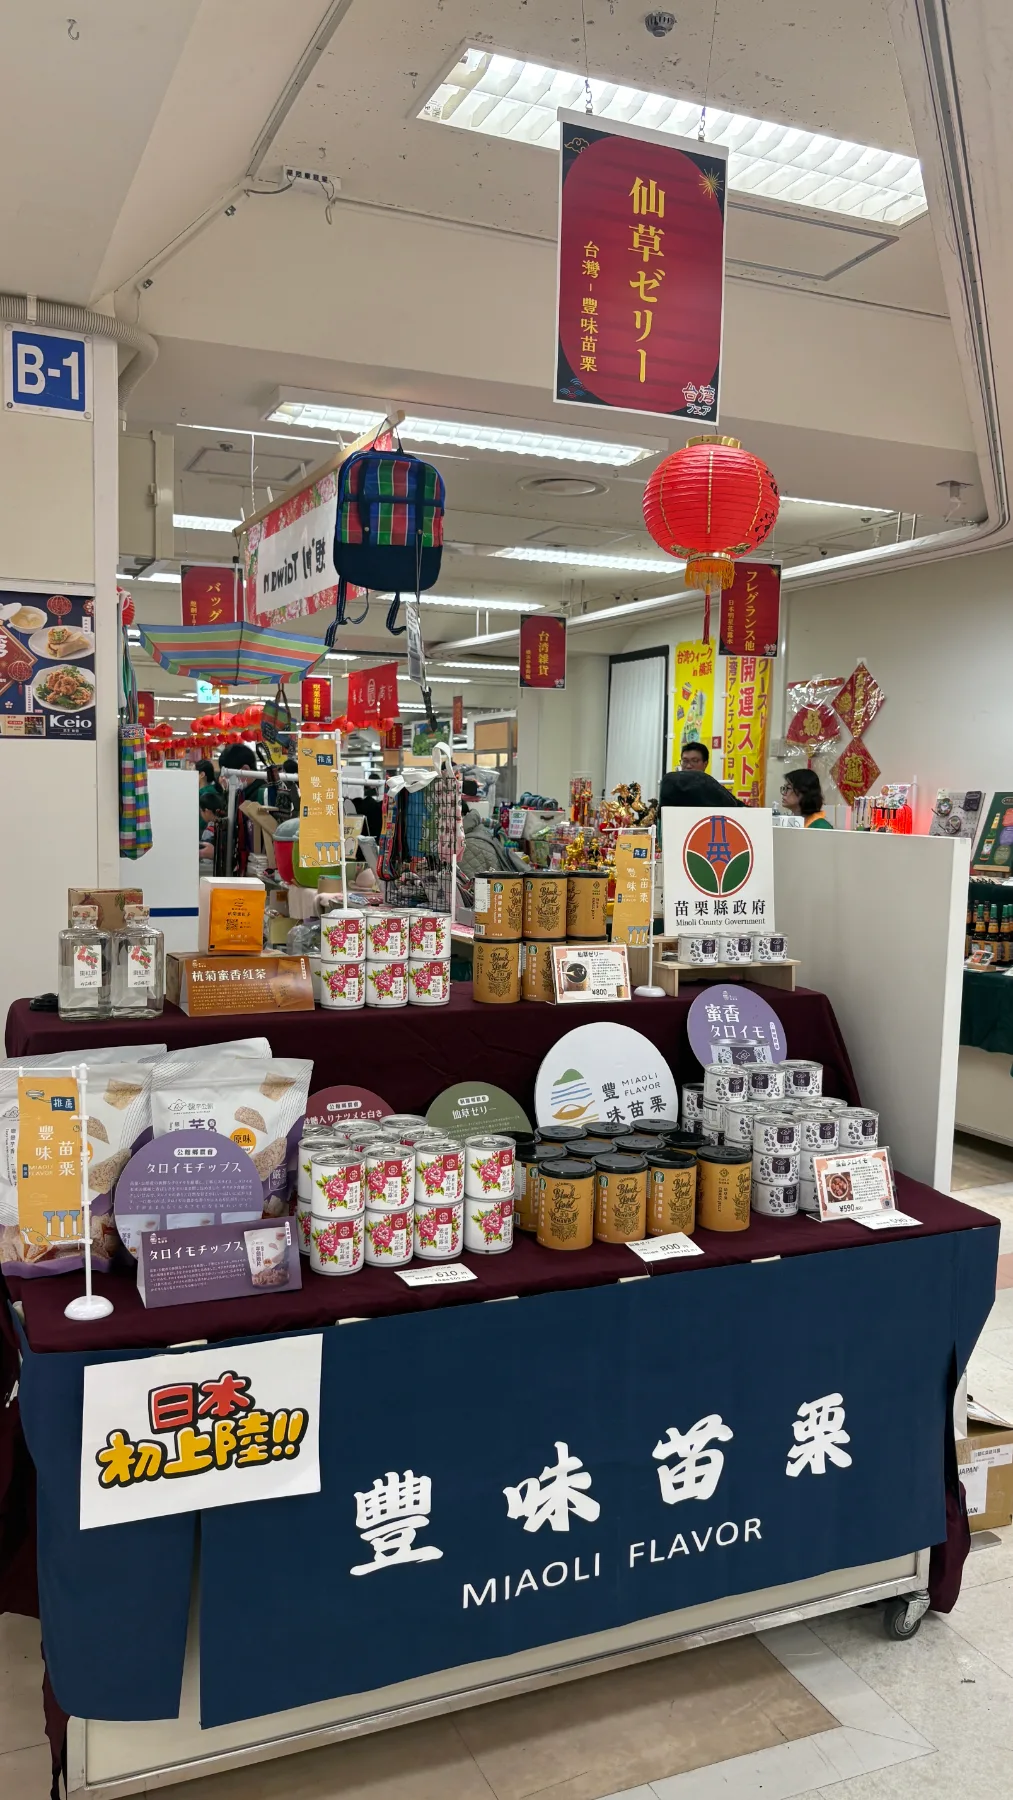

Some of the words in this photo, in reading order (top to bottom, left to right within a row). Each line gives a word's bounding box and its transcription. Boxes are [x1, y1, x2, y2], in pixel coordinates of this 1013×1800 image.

[628, 176, 666, 384] 仙草ゼリー
[17, 343, 79, 400] B-1
[681, 381, 716, 404] 台湾
[686, 402, 712, 416] フェア
[205, 582, 223, 623] バッグ
[743, 570, 759, 652] フレグランス他
[676, 647, 713, 665] 台湾ウィーク
[692, 667, 698, 677] in
[698, 661, 713, 678] 横浜
[50, 714, 92, 728] Keio
[674, 899, 766, 917] 苗栗縣政府
[698, 918, 723, 927] County
[724, 917, 766, 926] Government
[191, 968, 267, 982] 杭菊蜜香紅茶
[592, 988, 608, 996] ¥800
[704, 1003, 740, 1023] 蜜香
[710, 1024, 766, 1039] タロイモ
[621, 1072, 658, 1087] MIAOLI
[624, 1081, 661, 1097] FLAVOR
[53, 1097, 74, 1109] 推薦
[452, 1105, 497, 1120] 仙草ゼリー
[35, 1124, 54, 1161] 豐味
[233, 1134, 252, 1143] 原味
[58, 1140, 76, 1177] 苗栗
[146, 1161, 243, 1174] タロイモチップス
[552, 1187, 581, 1201] Black
[615, 1183, 642, 1197] Black
[553, 1199, 578, 1213] Gold
[617, 1194, 639, 1209] Gold
[838, 1203, 855, 1214] ¥590
[149, 1240, 245, 1261] タロイモチップス
[659, 1243, 681, 1252] 800
[435, 1270, 458, 1278] 610
[147, 1369, 257, 1435] 日本
[462, 1552, 601, 1610] MIAOLI
[628, 1517, 763, 1569] FLAVOR
